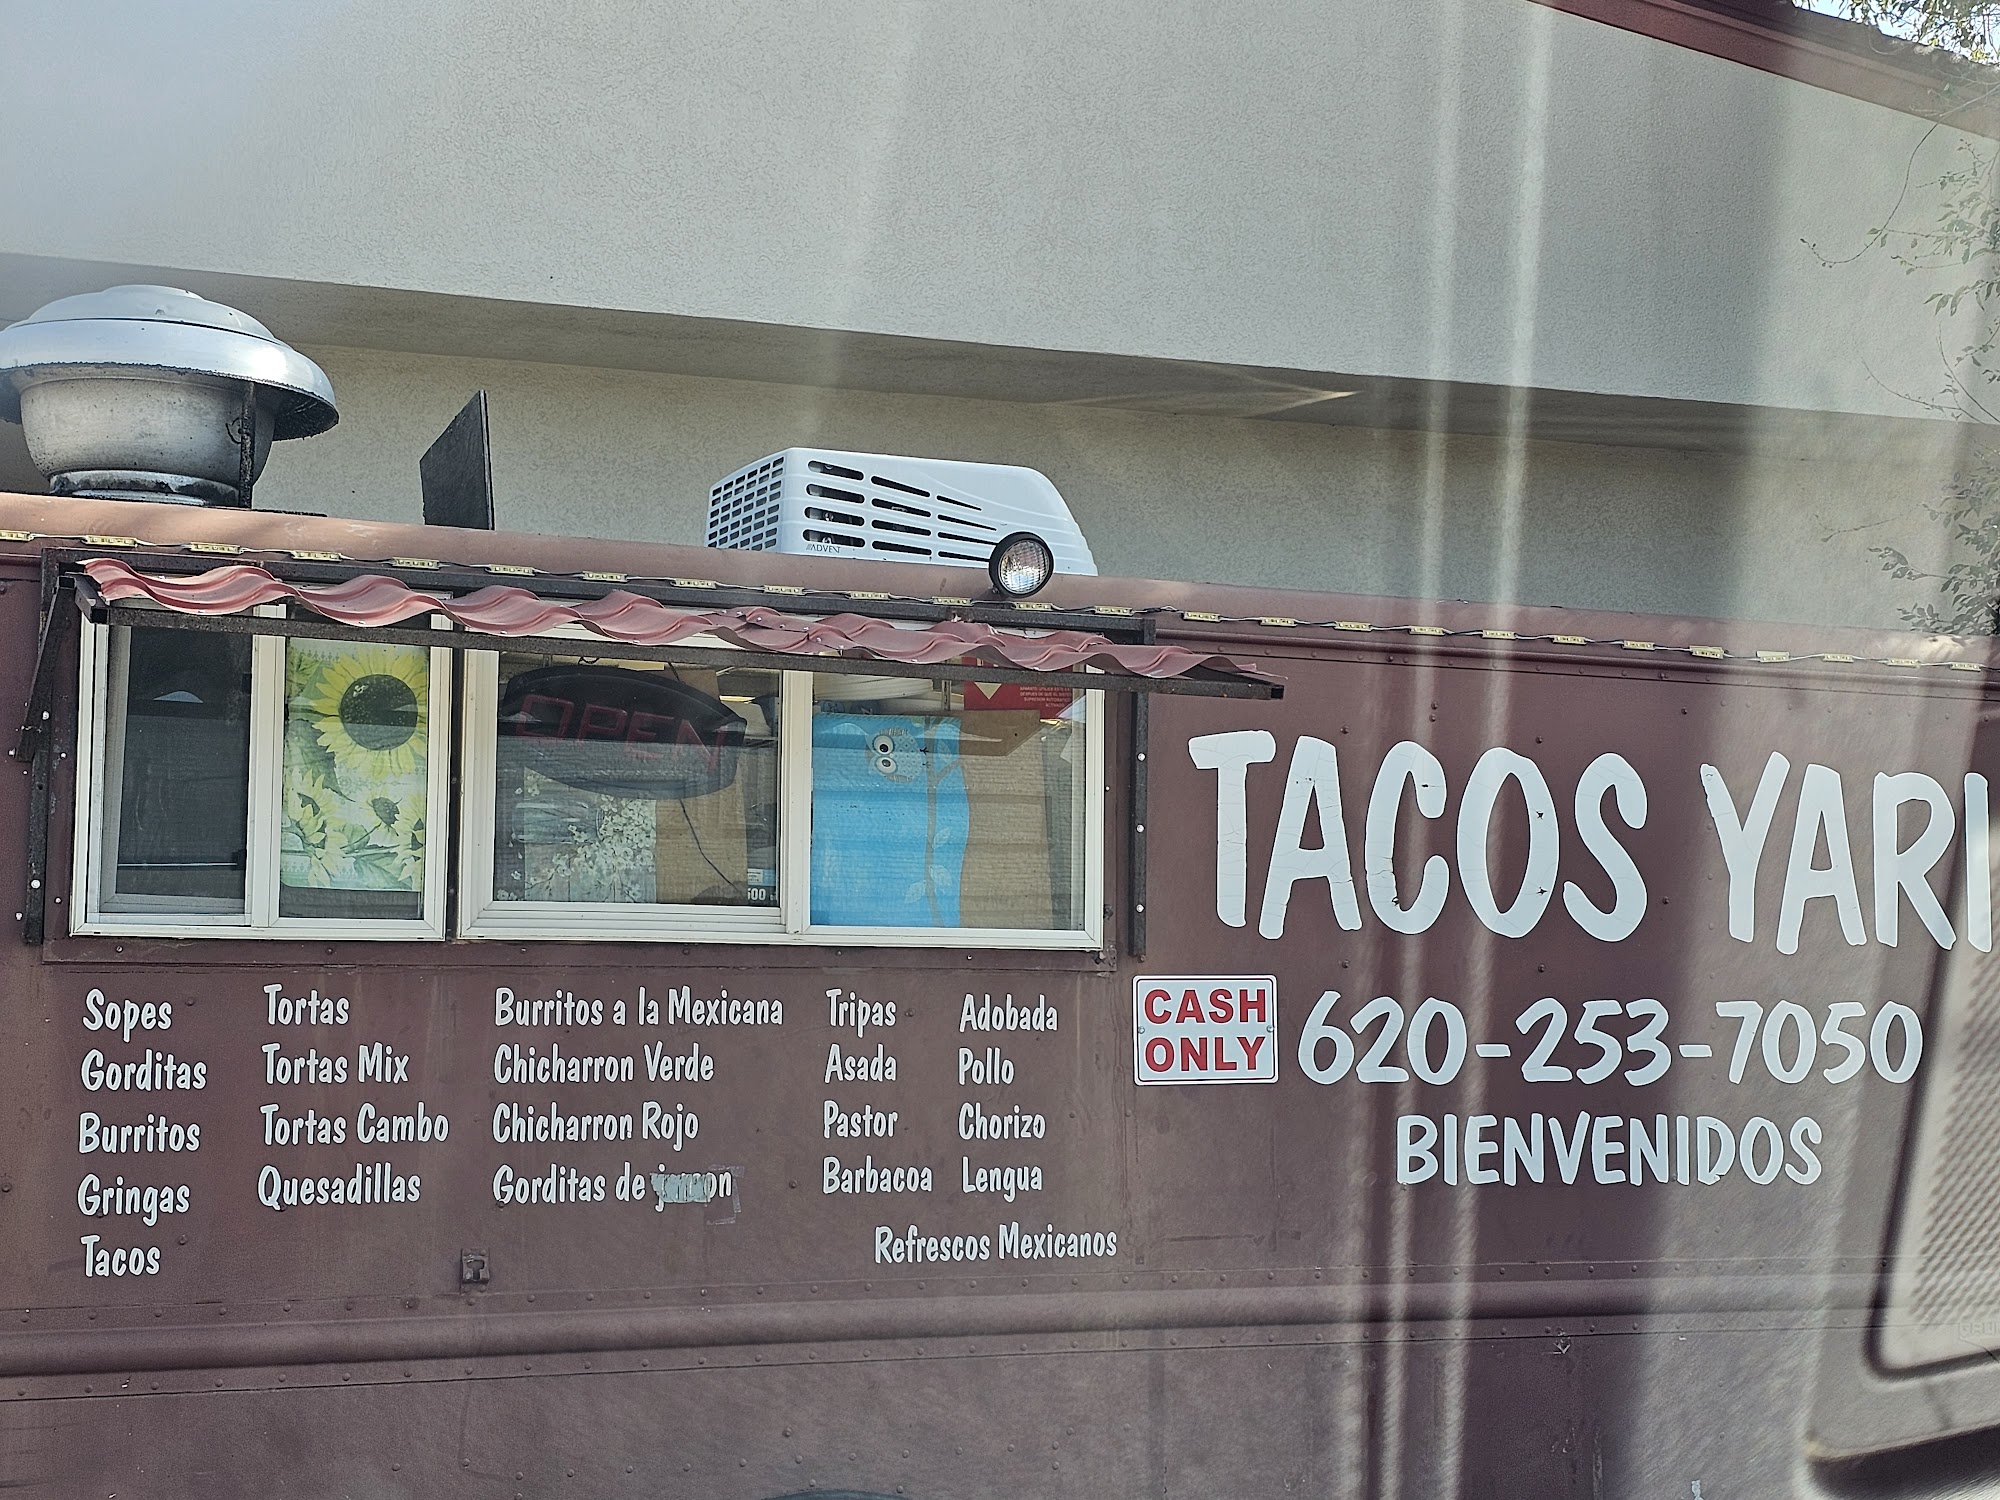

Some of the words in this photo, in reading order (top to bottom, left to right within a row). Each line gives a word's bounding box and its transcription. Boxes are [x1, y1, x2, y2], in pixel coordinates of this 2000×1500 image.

[809, 544, 841, 554] ADVENT
[516, 694, 727, 770] OPEN
[1188, 729, 1648, 942] TACOS
[1700, 751, 1993, 955] YARI
[82, 988, 172, 1043] Sopes
[263, 983, 349, 1025] Tortas
[495, 987, 604, 1027] Burritos
[612, 999, 626, 1026] a
[638, 986, 659, 1026] la
[668, 985, 783, 1027] Mexicana
[825, 988, 896, 1039] Tripas
[959, 993, 1058, 1033] Adobada
[1144, 988, 1267, 1025] CASH
[1145, 1036, 1266, 1073] ONLY
[1297, 990, 1923, 1087] 620-253-7050
[81, 1048, 207, 1092] Gorditas
[261, 1042, 348, 1085] Tortas
[358, 1041, 410, 1084] Mix
[494, 1043, 634, 1084] Chicharron
[643, 1040, 714, 1082] Verde
[824, 1043, 897, 1084] Asada
[958, 1047, 1014, 1086] Pollo
[78, 1112, 200, 1154] Burritos
[260, 1103, 347, 1146] Tortas
[357, 1101, 449, 1144] Cambo
[492, 1101, 633, 1143] Chicharron
[642, 1101, 699, 1152] Rojo
[823, 1100, 898, 1139] Pastor
[958, 1102, 1046, 1140] Chorizo
[1396, 1110, 1823, 1187] BIENVENIDOS
[257, 1162, 421, 1211] Quesadillas
[492, 1163, 606, 1204] Gorditas
[615, 1161, 646, 1202] de
[654, 1163, 732, 1212] jon
[822, 1155, 932, 1195] Barbacoa
[962, 1156, 1042, 1203] Lengua
[77, 1173, 190, 1227] Gringas
[80, 1234, 161, 1277] Tacos
[875, 1224, 991, 1264] Refrescos
[998, 1221, 1117, 1260] Mexicanos
